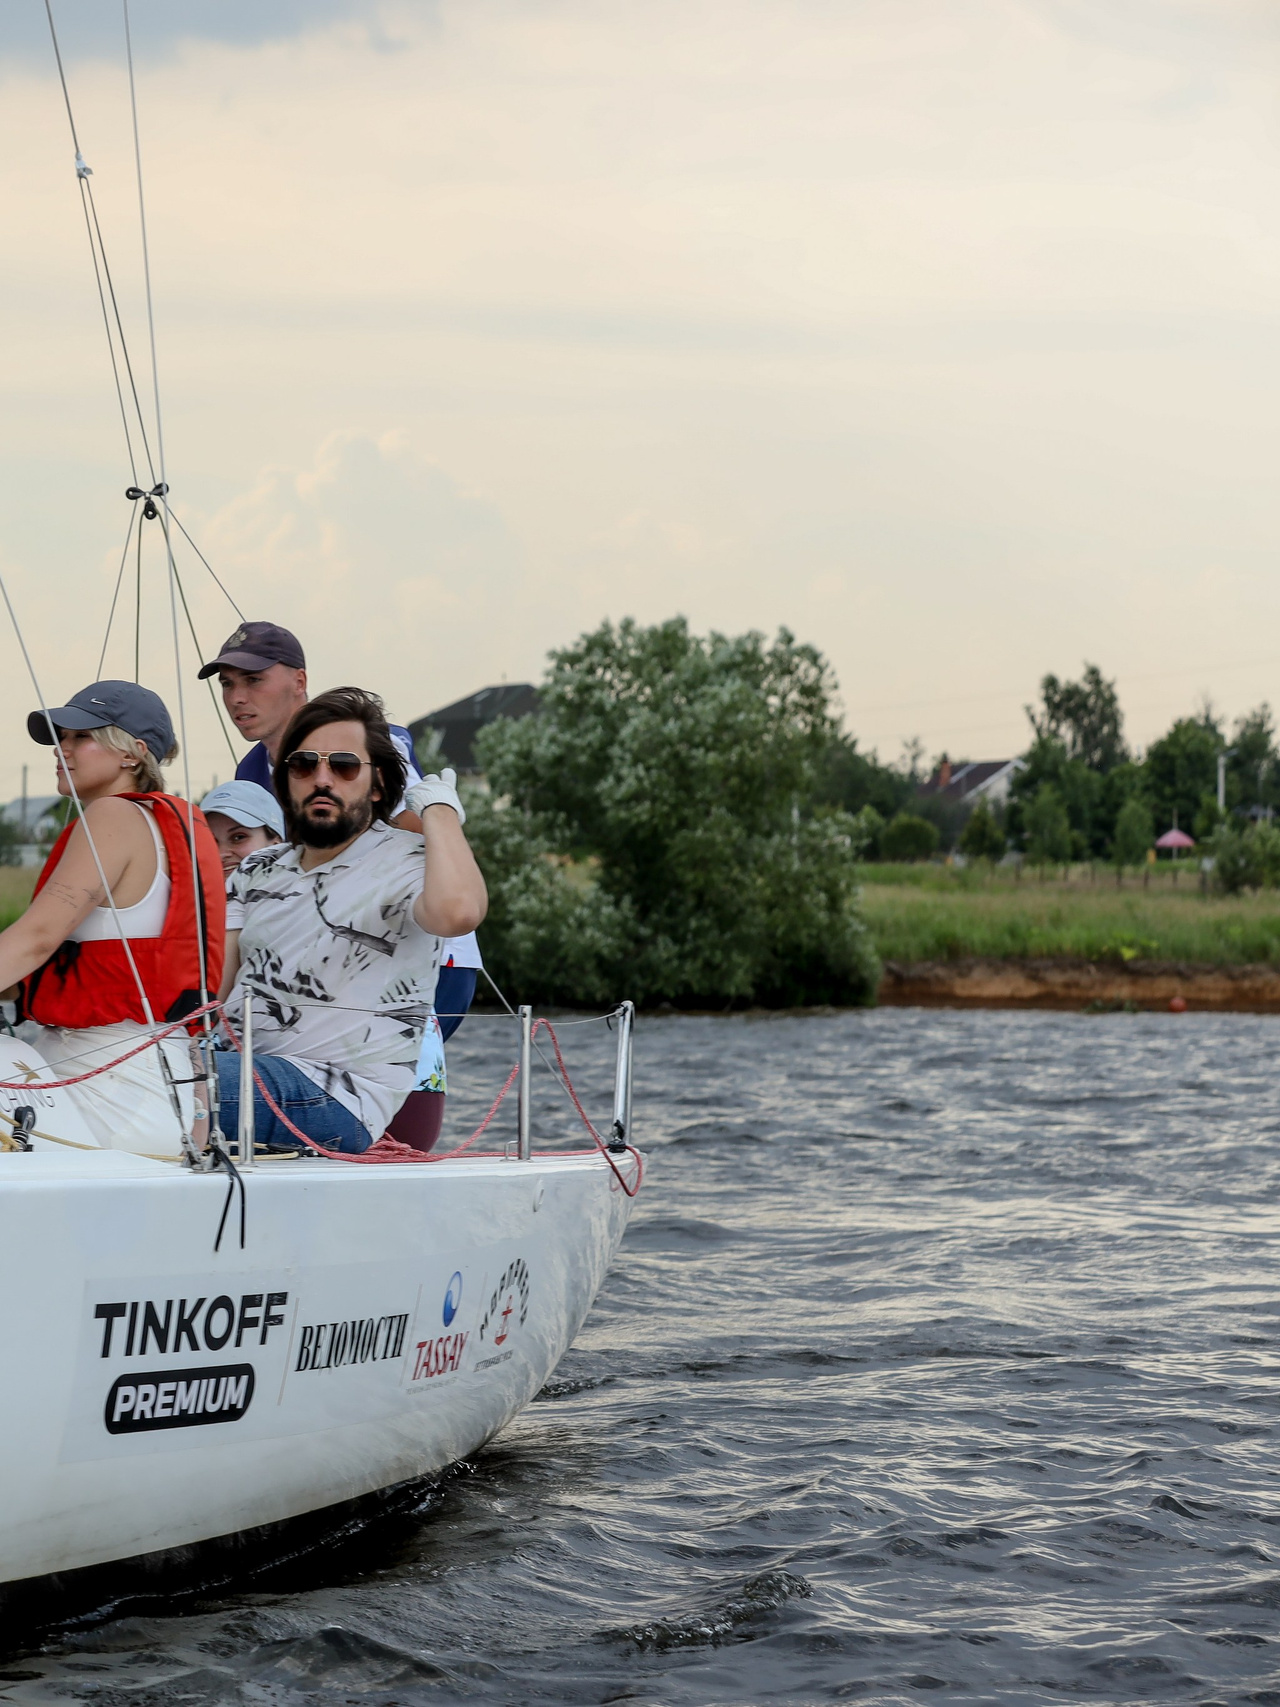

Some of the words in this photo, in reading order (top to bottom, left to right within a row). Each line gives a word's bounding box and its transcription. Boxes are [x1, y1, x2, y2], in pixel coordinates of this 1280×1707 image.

[94, 1292, 288, 1358] TINKOFF
[295, 1313, 410, 1373] ВЕДОМОСТИ
[411, 1331, 470, 1380] TASSAY
[112, 1375, 249, 1422] PREMIUM
